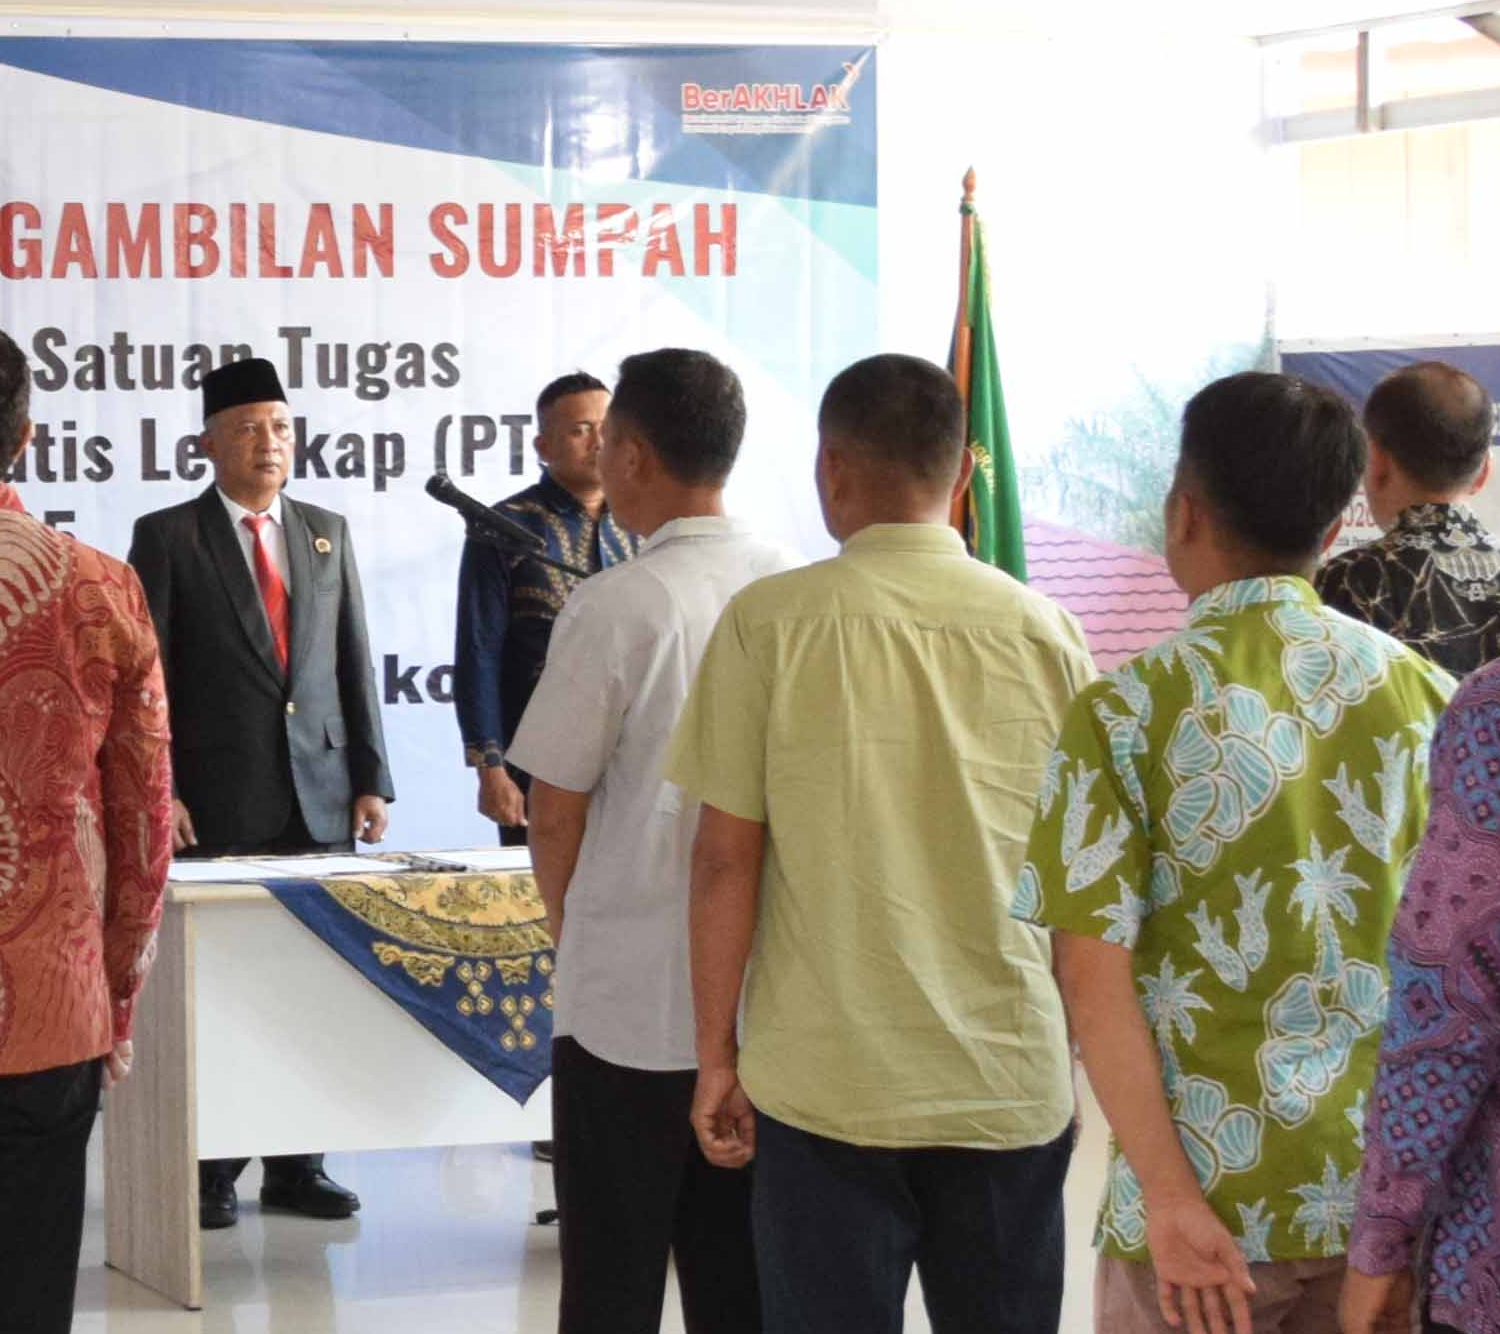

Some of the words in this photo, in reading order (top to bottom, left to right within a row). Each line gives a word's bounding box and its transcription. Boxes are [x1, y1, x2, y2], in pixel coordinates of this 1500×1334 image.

[682, 82, 850, 111] BerAKHLAK
[428, 201, 738, 280] SUMPAH
[278, 327, 461, 402] Tugas
[141, 418, 406, 491] Lekap
